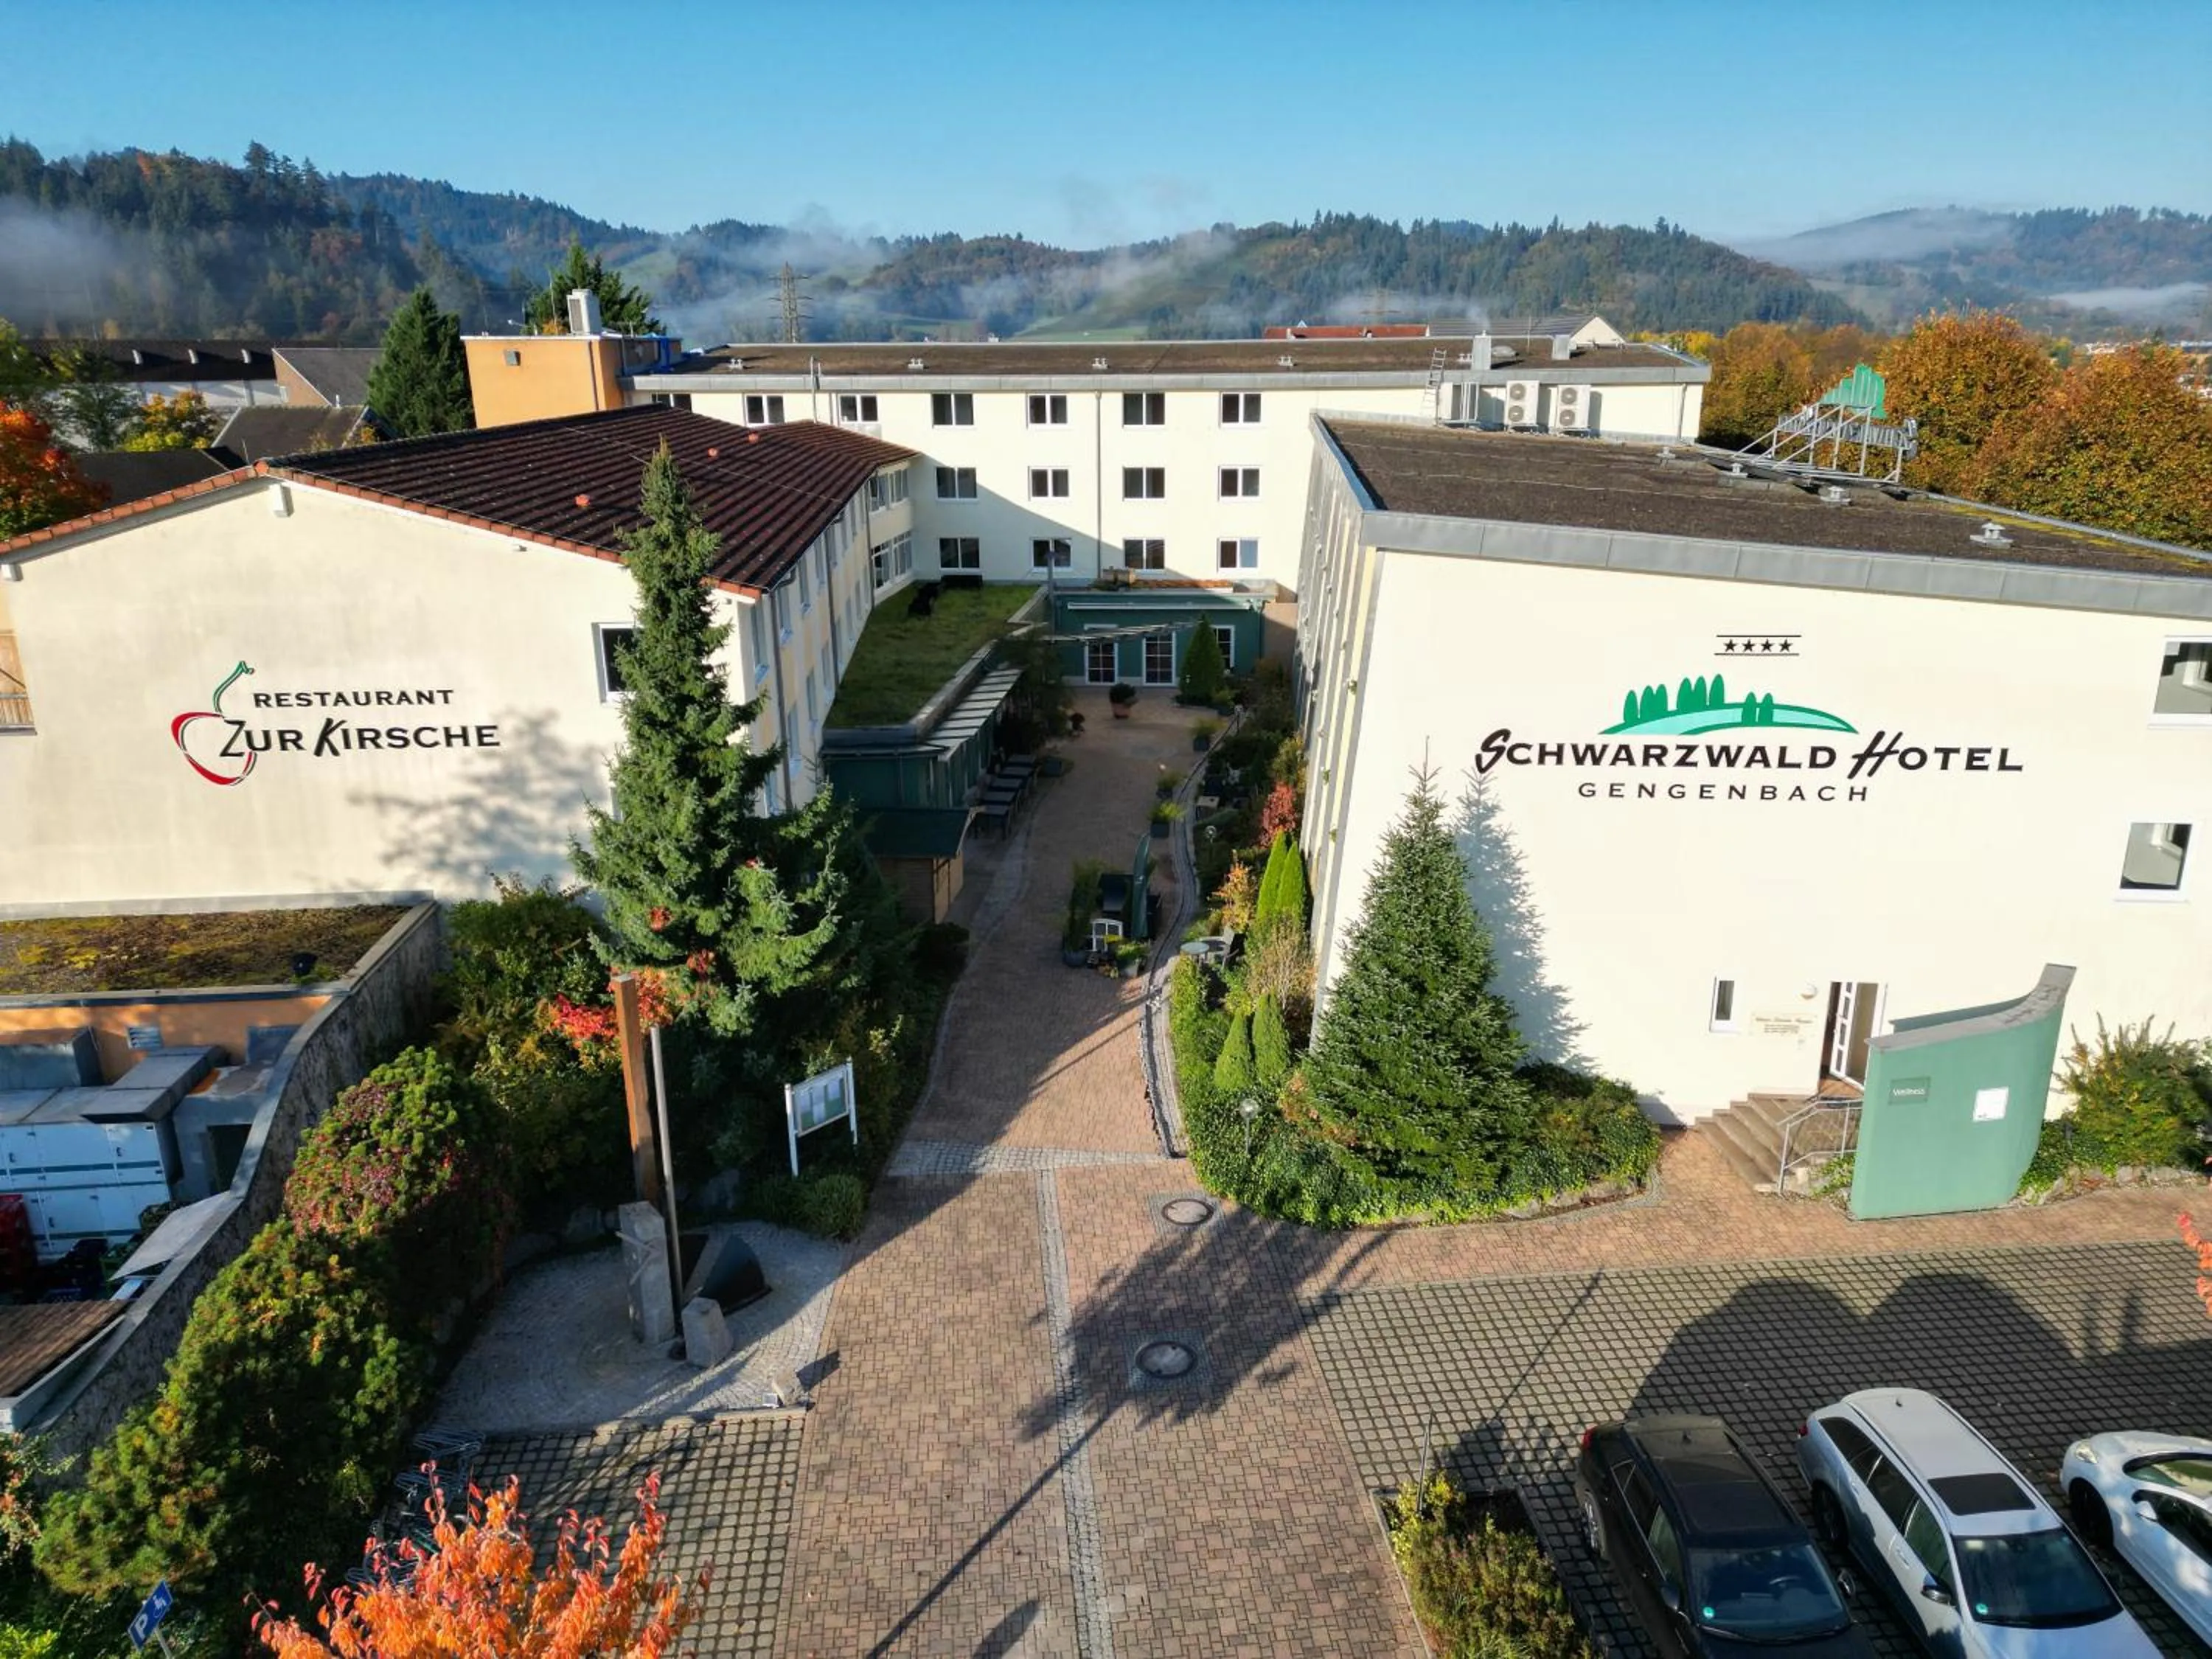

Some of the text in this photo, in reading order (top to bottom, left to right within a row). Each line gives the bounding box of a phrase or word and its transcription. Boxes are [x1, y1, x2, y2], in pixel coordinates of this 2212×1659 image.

[253, 689, 453, 708] RESTAURANT
[220, 717, 501, 757] ZUR KIRSCHE
[1475, 728, 2023, 779] SCHWARZWALD HOTEL
[1579, 782, 1867, 801] GENGENBACH
[135, 1613, 148, 1641] P
